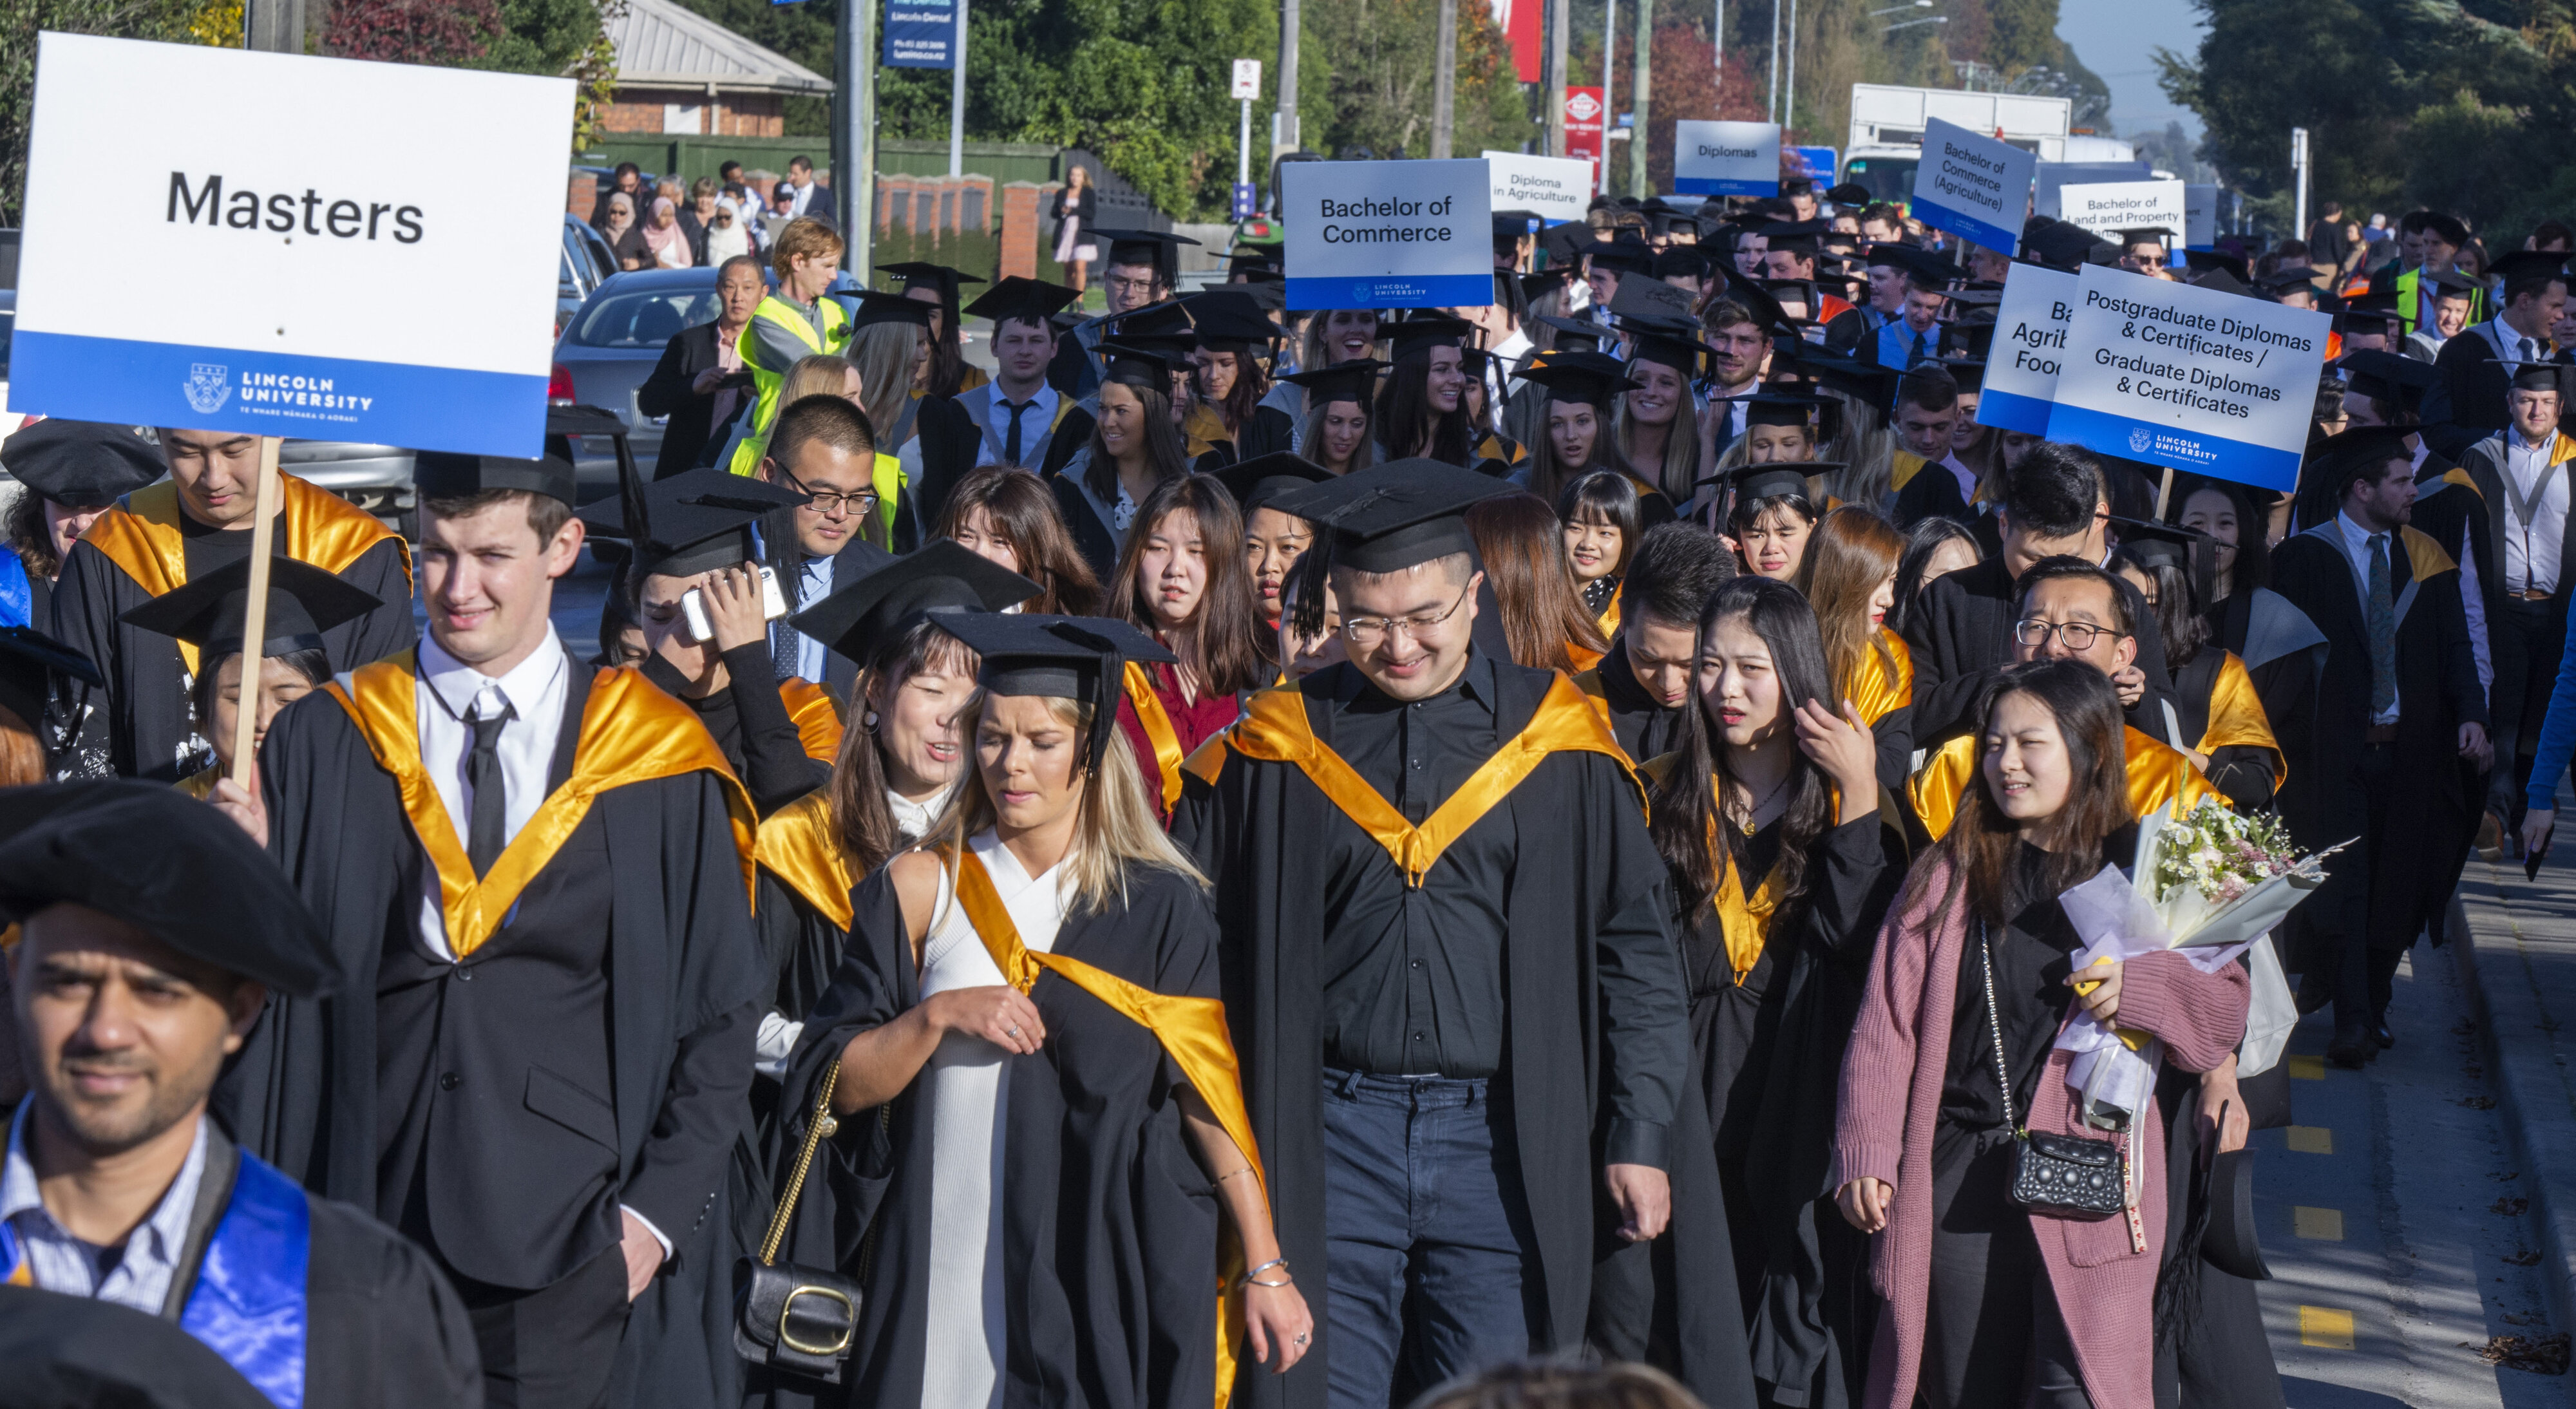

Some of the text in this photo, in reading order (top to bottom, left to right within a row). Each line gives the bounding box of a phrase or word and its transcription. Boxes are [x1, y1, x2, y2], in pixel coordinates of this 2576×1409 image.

[1698, 145, 1757, 158] Diplomas
[1944, 142, 2005, 175] Bachelor of
[1510, 174, 1562, 189] Diploma
[1942, 160, 2001, 191] Commerce
[1493, 185, 1577, 203] in Agriculture
[1935, 175, 2002, 213] (Agriculture)
[2088, 197, 2157, 210] Bachelor of
[167, 171, 423, 244] Masters
[1321, 196, 1452, 217] Bachelor of
[2099, 213, 2123, 223] and
[2126, 212, 2179, 224] Property
[1323, 225, 1452, 243] Commerce
[2087, 290, 2312, 352] Postgraduate Diplomas
[2121, 321, 2269, 368] & Certificates /
[242, 372, 334, 392] LINCOLN
[2094, 348, 2281, 402] Graduate Diplomas
[241, 388, 372, 411] UNIVERSITY
[2116, 377, 2249, 419] & Certificates
[252, 408, 280, 416] WHARE
[2155, 442, 2217, 460] UNIVERSITY
[2157, 435, 2200, 449] LINCOLN
